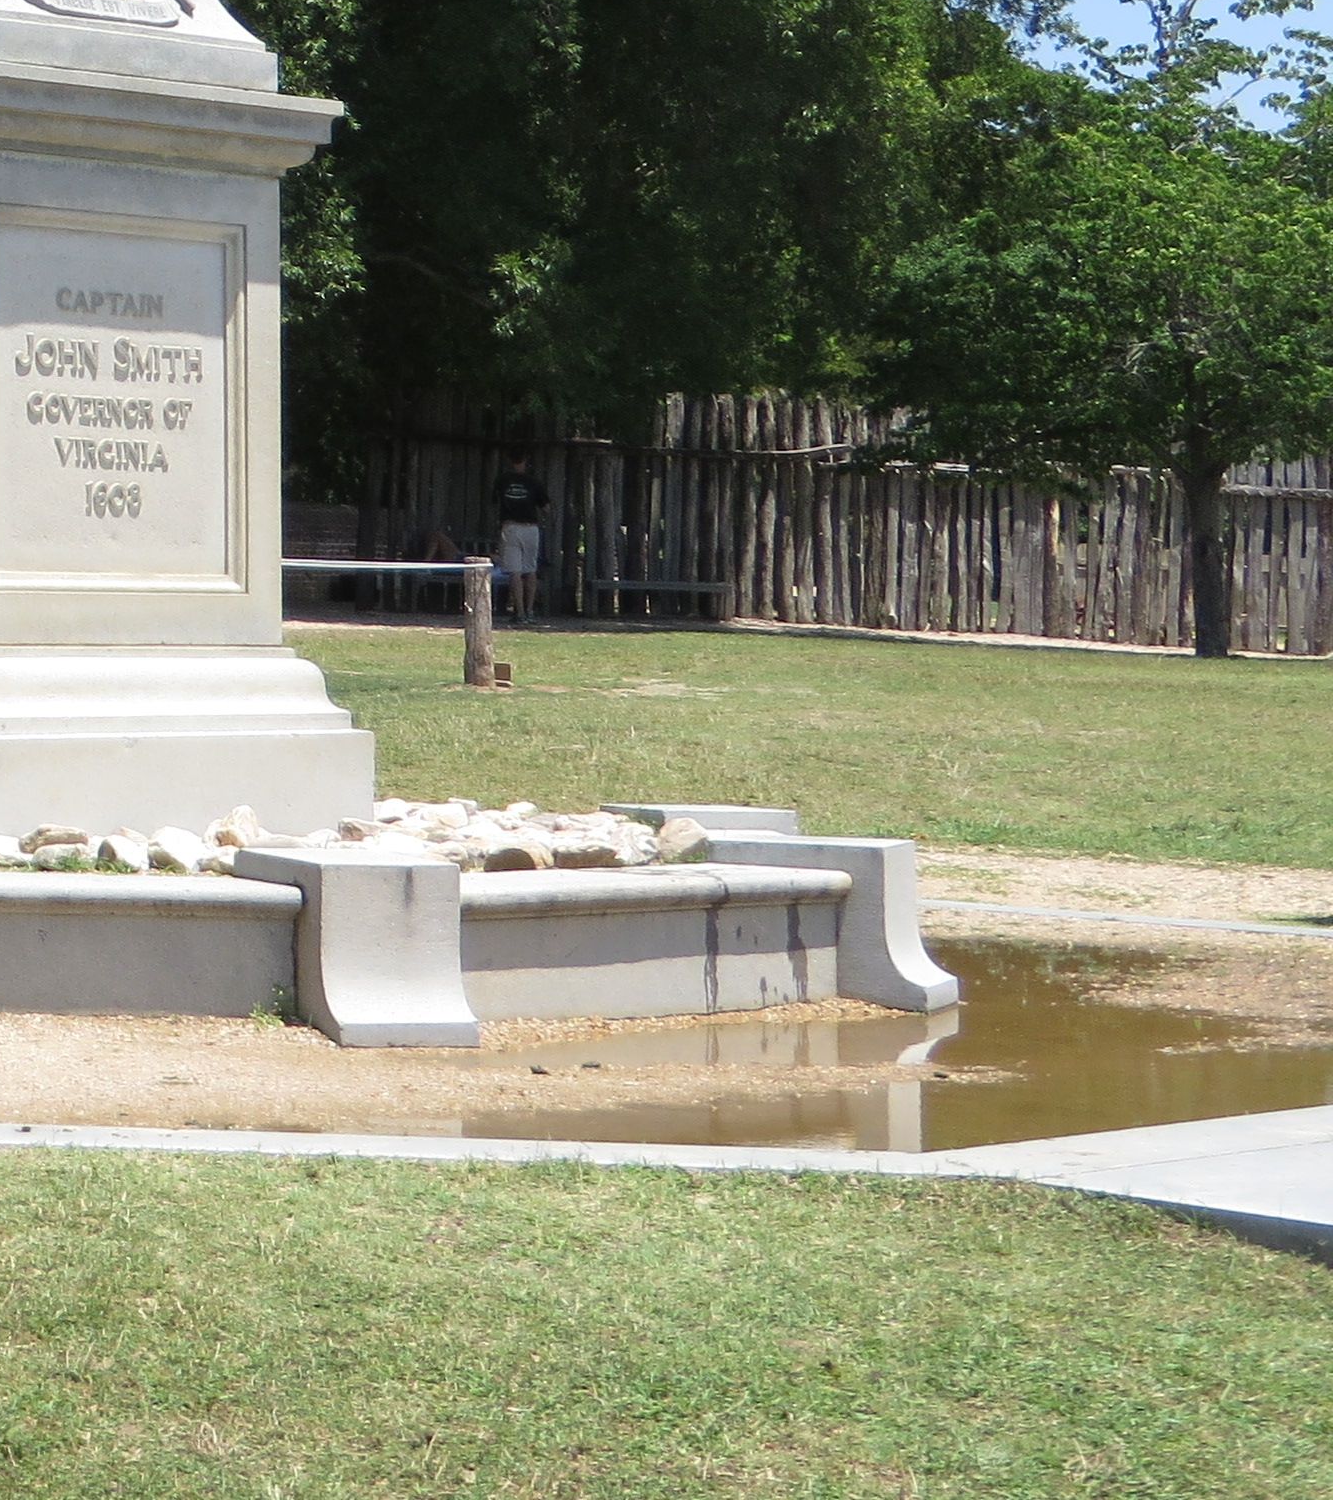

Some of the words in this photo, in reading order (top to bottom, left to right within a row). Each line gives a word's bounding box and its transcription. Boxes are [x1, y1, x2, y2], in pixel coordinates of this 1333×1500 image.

[101, 0, 121, 14] EST
[55, 287, 164, 318] CAPTAIN
[15, 332, 99, 381] JOHN
[113, 336, 203, 384] SMITH
[26, 391, 153, 430] GOVERNOR
[163, 398, 193, 430] OF
[54, 436, 169, 473] VIRGINIA
[85, 480, 142, 519] 1608
